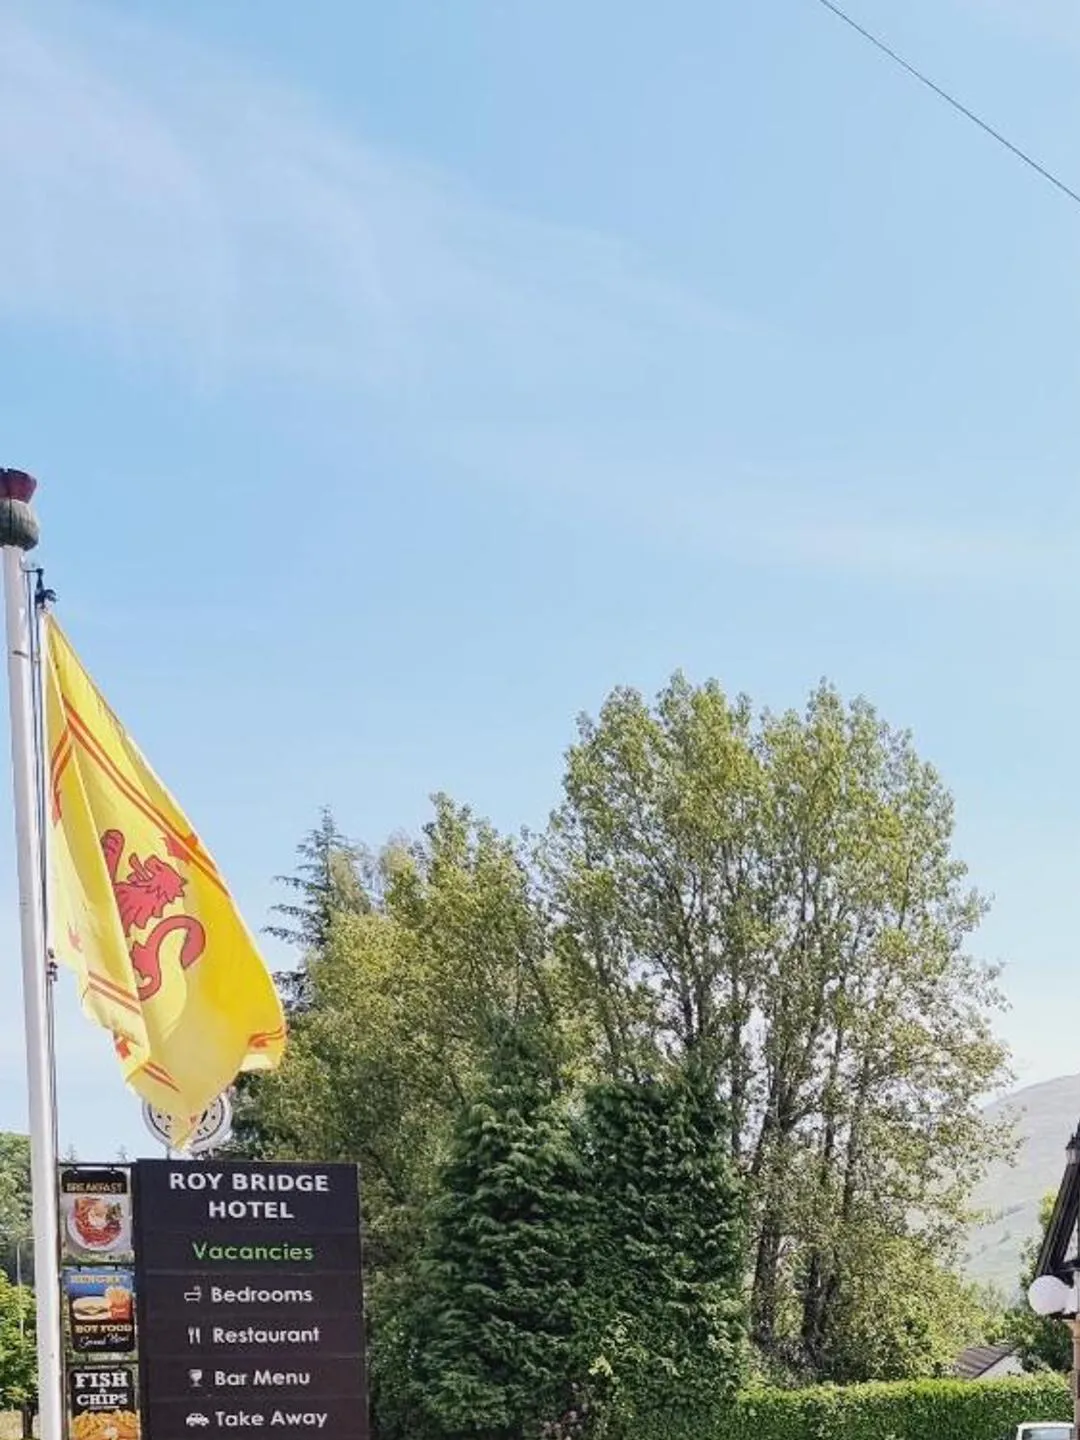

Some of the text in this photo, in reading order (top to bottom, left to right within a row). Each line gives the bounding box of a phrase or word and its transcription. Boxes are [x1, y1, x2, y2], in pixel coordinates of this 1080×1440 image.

[66, 1182, 124, 1192] BREAKFAST
[169, 1172, 330, 1192] ROY BRIDGE
[208, 1201, 295, 1219] HOTEL
[191, 1241, 315, 1260] Vacancies
[210, 1286, 313, 1303] Bedrooms
[100, 1324, 133, 1332] FOOD
[212, 1326, 320, 1344] Restaurant
[74, 1371, 129, 1388] FISH
[214, 1369, 311, 1386] Bar Menu
[76, 1393, 129, 1406] CHIPS
[215, 1410, 328, 1428] Take Away
